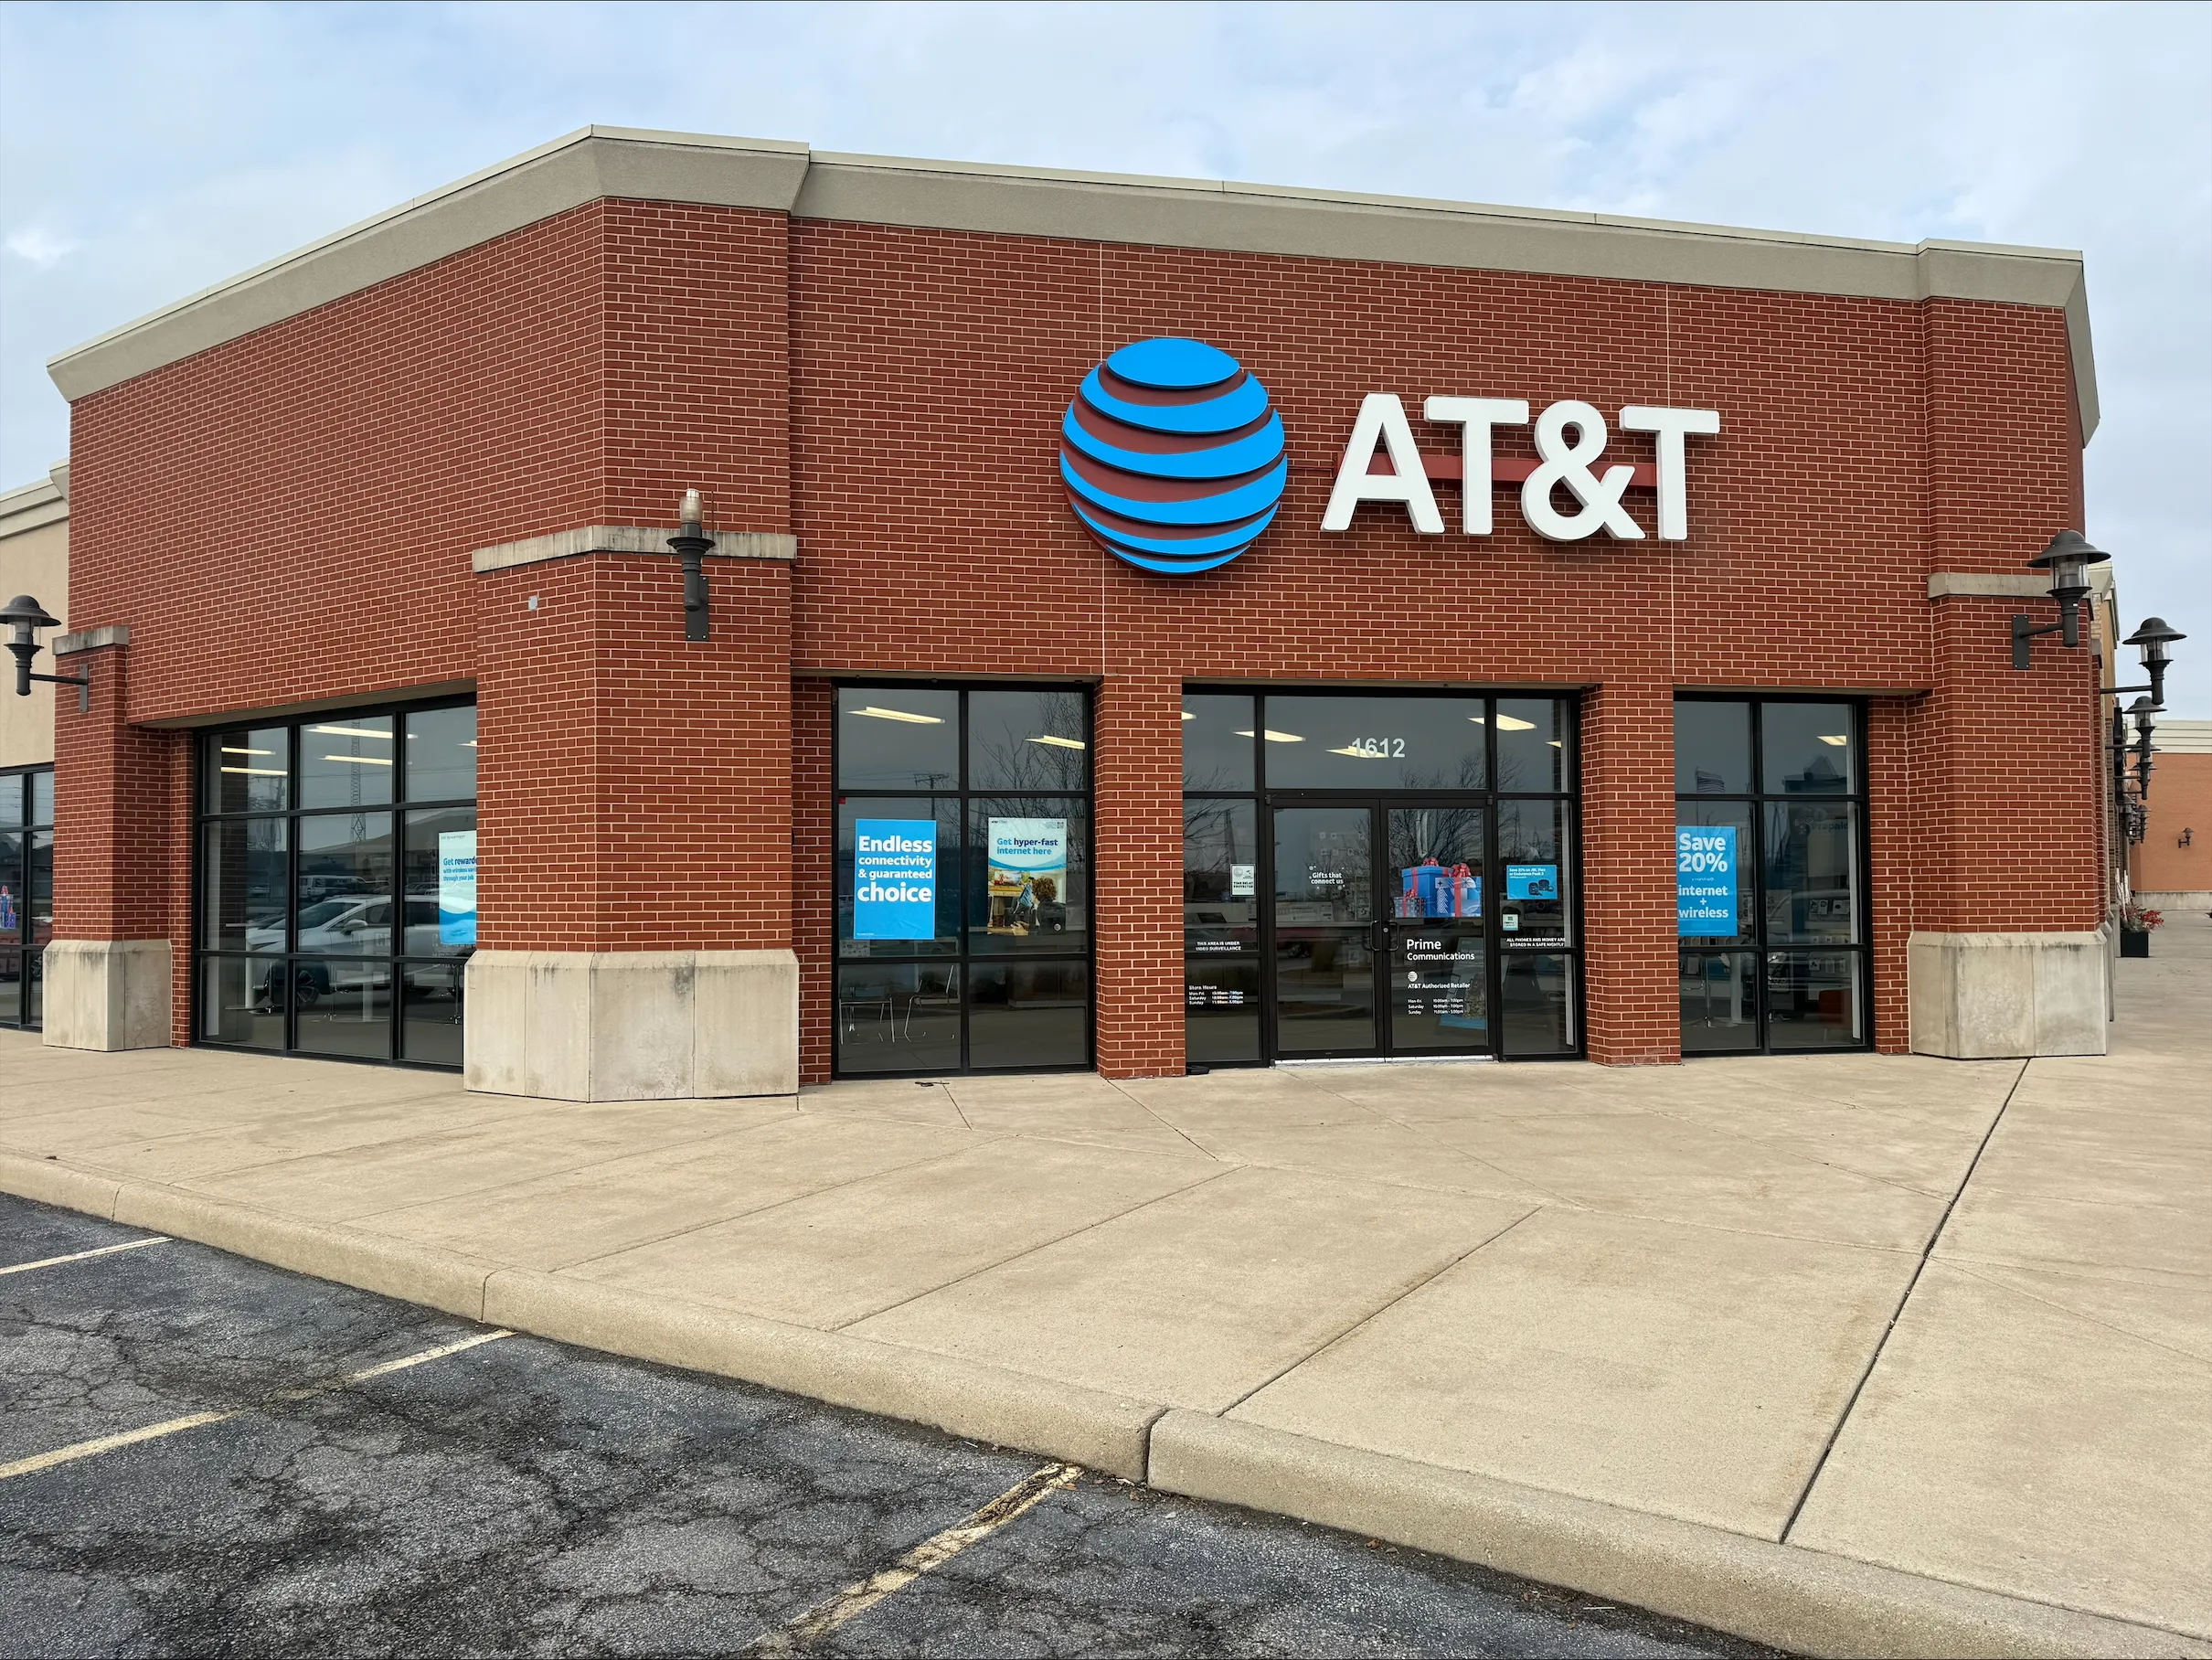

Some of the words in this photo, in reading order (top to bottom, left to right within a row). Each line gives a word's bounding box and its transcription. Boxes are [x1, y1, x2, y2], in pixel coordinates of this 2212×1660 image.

[1320, 393, 1720, 542] AT&T
[1352, 737, 1405, 758] 1612
[858, 835, 932, 853] Endless
[997, 837, 1012, 846] Get
[1014, 837, 1058, 847] hyper-fast
[1679, 833, 1727, 851] Save
[996, 846, 1031, 855] internet
[443, 857, 453, 866] Get
[858, 855, 932, 868] connectivity
[1679, 852, 1728, 872] 20%
[858, 868, 867, 878] &
[868, 868, 932, 880] guaranteed
[857, 881, 932, 902] choice
[1678, 884, 1728, 896] internet
[1678, 906, 1728, 919] wireless
[1407, 939, 1441, 950] Prime
[1407, 952, 1475, 961] Communications
